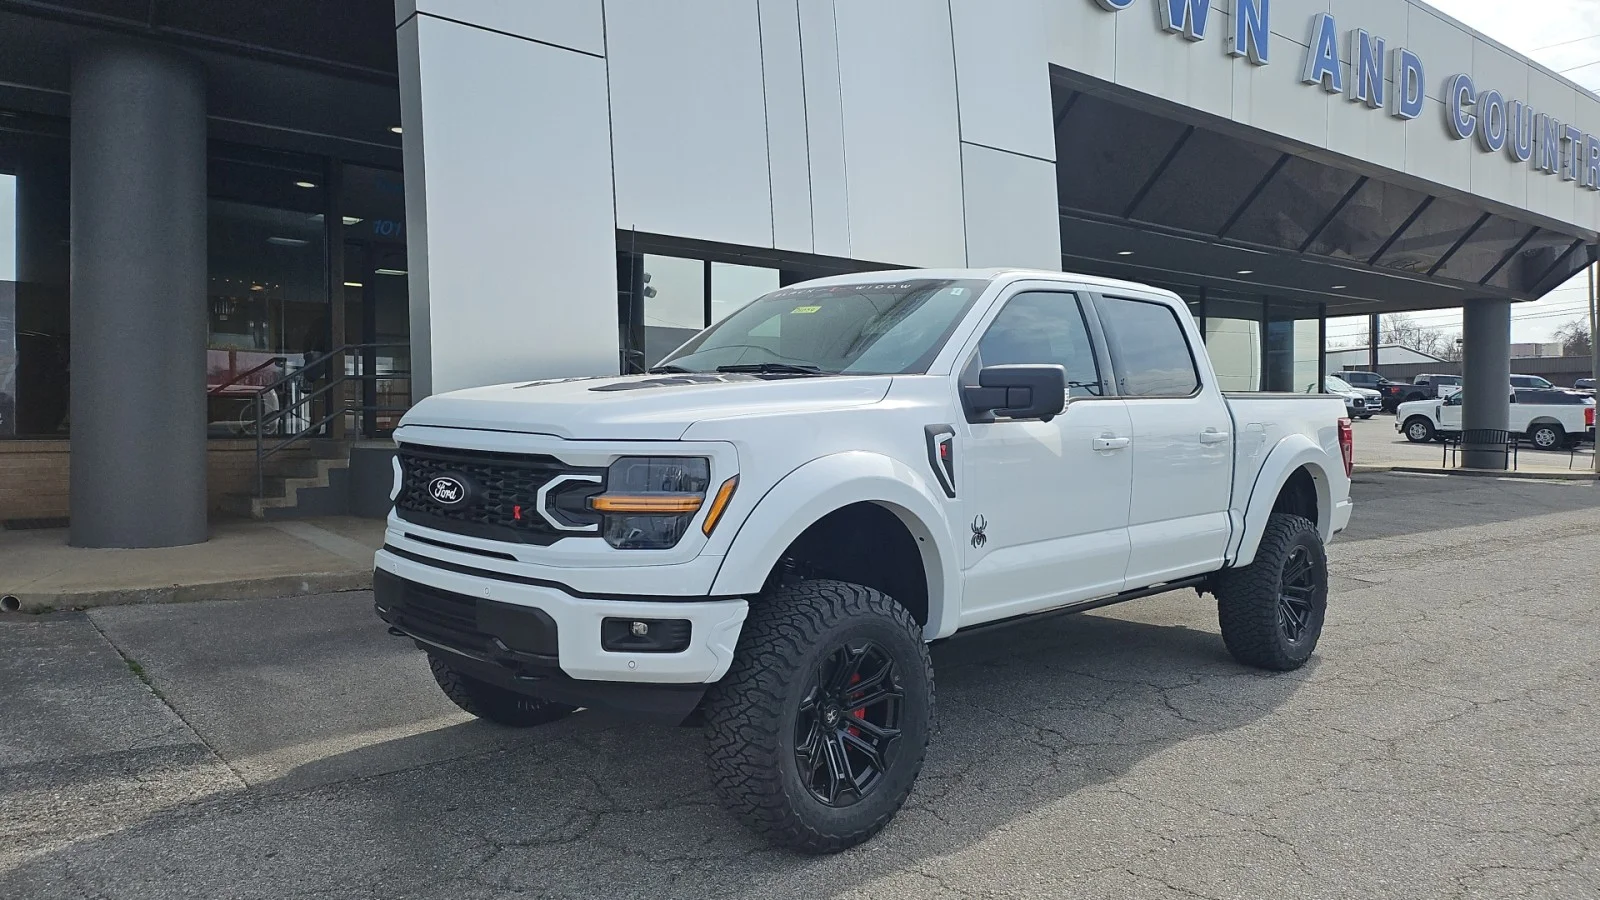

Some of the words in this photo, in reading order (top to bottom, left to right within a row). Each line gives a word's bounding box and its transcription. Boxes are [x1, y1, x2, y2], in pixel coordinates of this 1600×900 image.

[1303, 12, 1425, 119] AND
[1446, 73, 1600, 191] COUNTR
[434, 480, 457, 500] Ford
